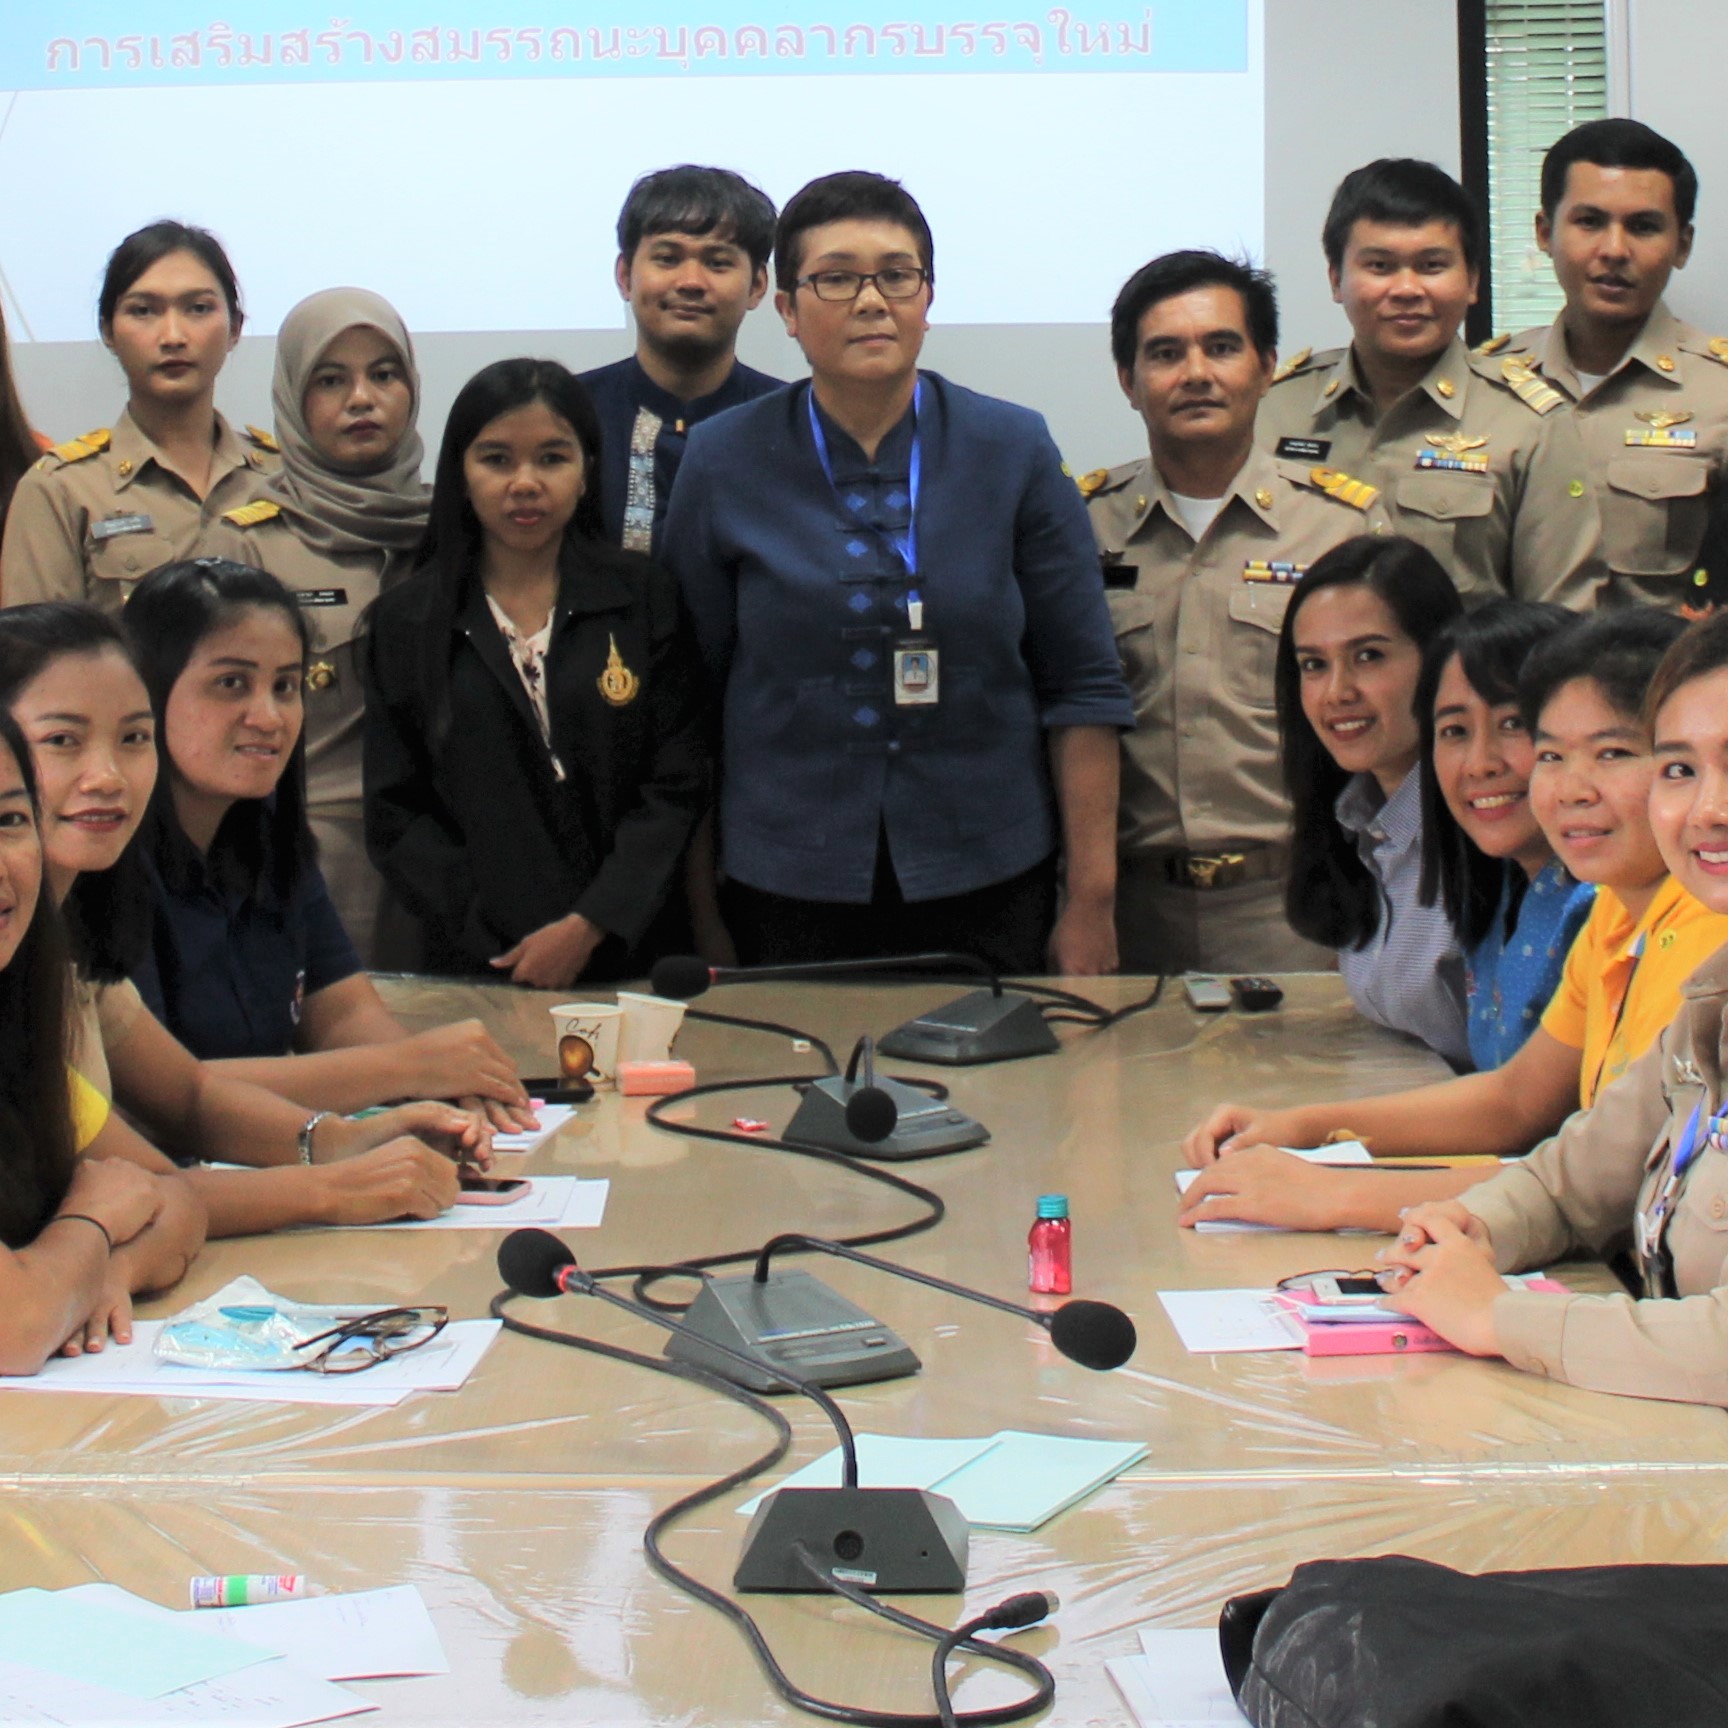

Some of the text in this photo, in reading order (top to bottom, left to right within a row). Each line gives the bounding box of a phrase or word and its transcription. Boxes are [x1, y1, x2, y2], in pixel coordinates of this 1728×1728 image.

[45, 8, 1154, 73] การเสริมสร้างสมรรถนะบุคคลากรบรรจุใหม่
